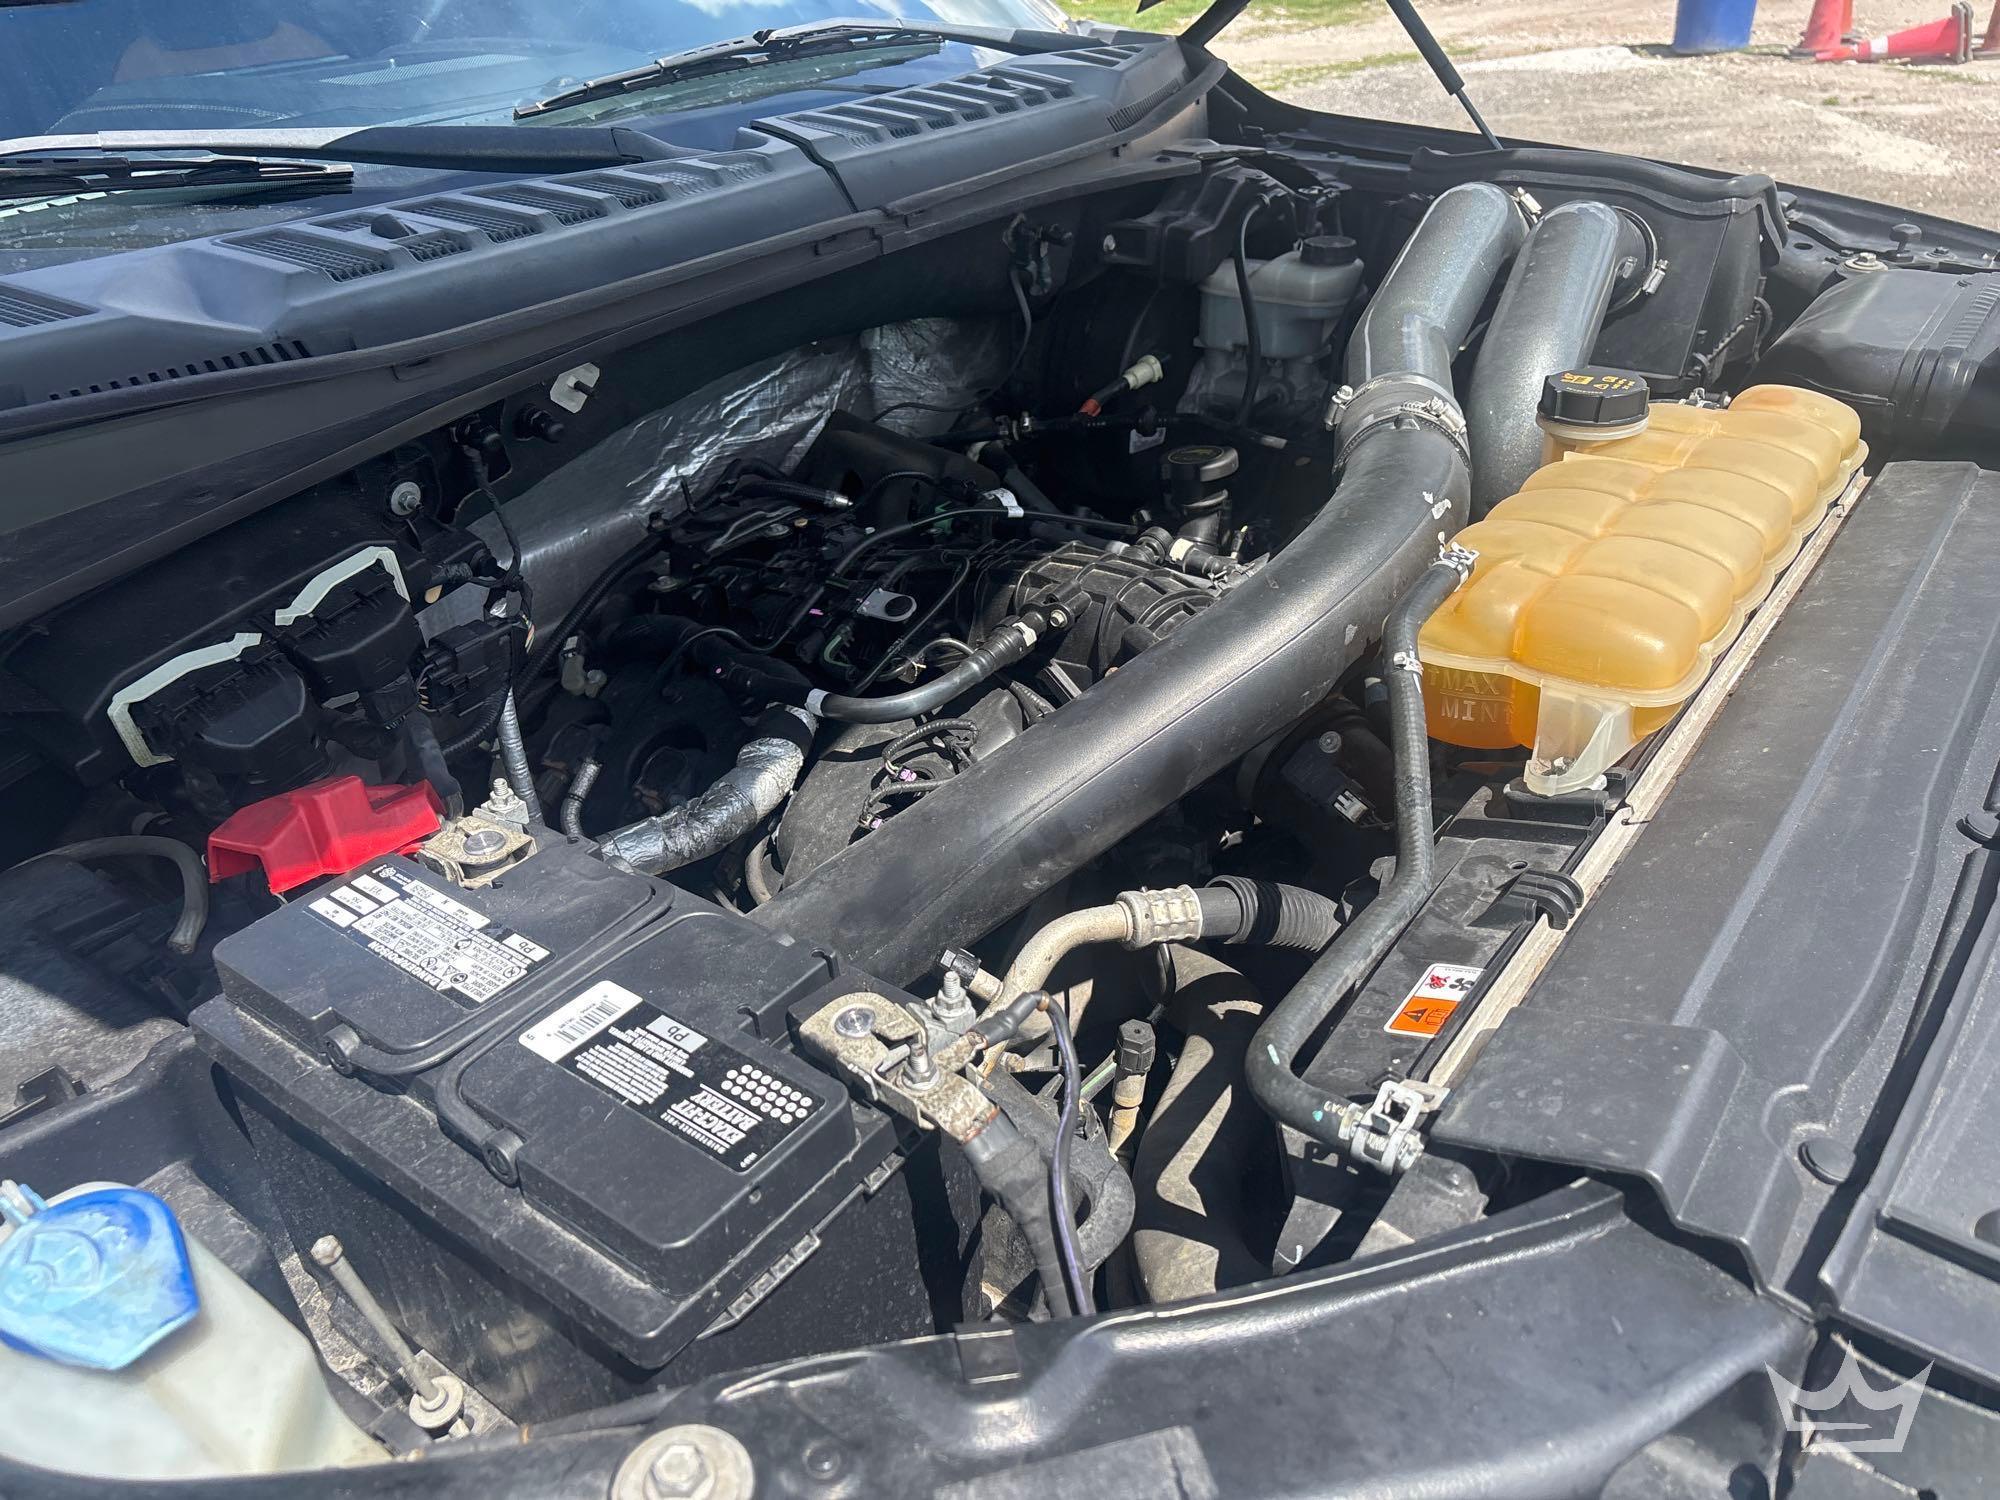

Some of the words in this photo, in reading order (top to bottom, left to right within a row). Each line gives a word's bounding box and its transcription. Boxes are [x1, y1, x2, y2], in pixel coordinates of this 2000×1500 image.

[1441, 668, 1501, 695] MAX
[1441, 696, 1498, 723] MIN
[518, 942, 536, 954] Pb
[666, 1024, 687, 1042] Pb
[671, 1099, 747, 1145] EXACT-FIT
[690, 1091, 759, 1132] BATTERY
